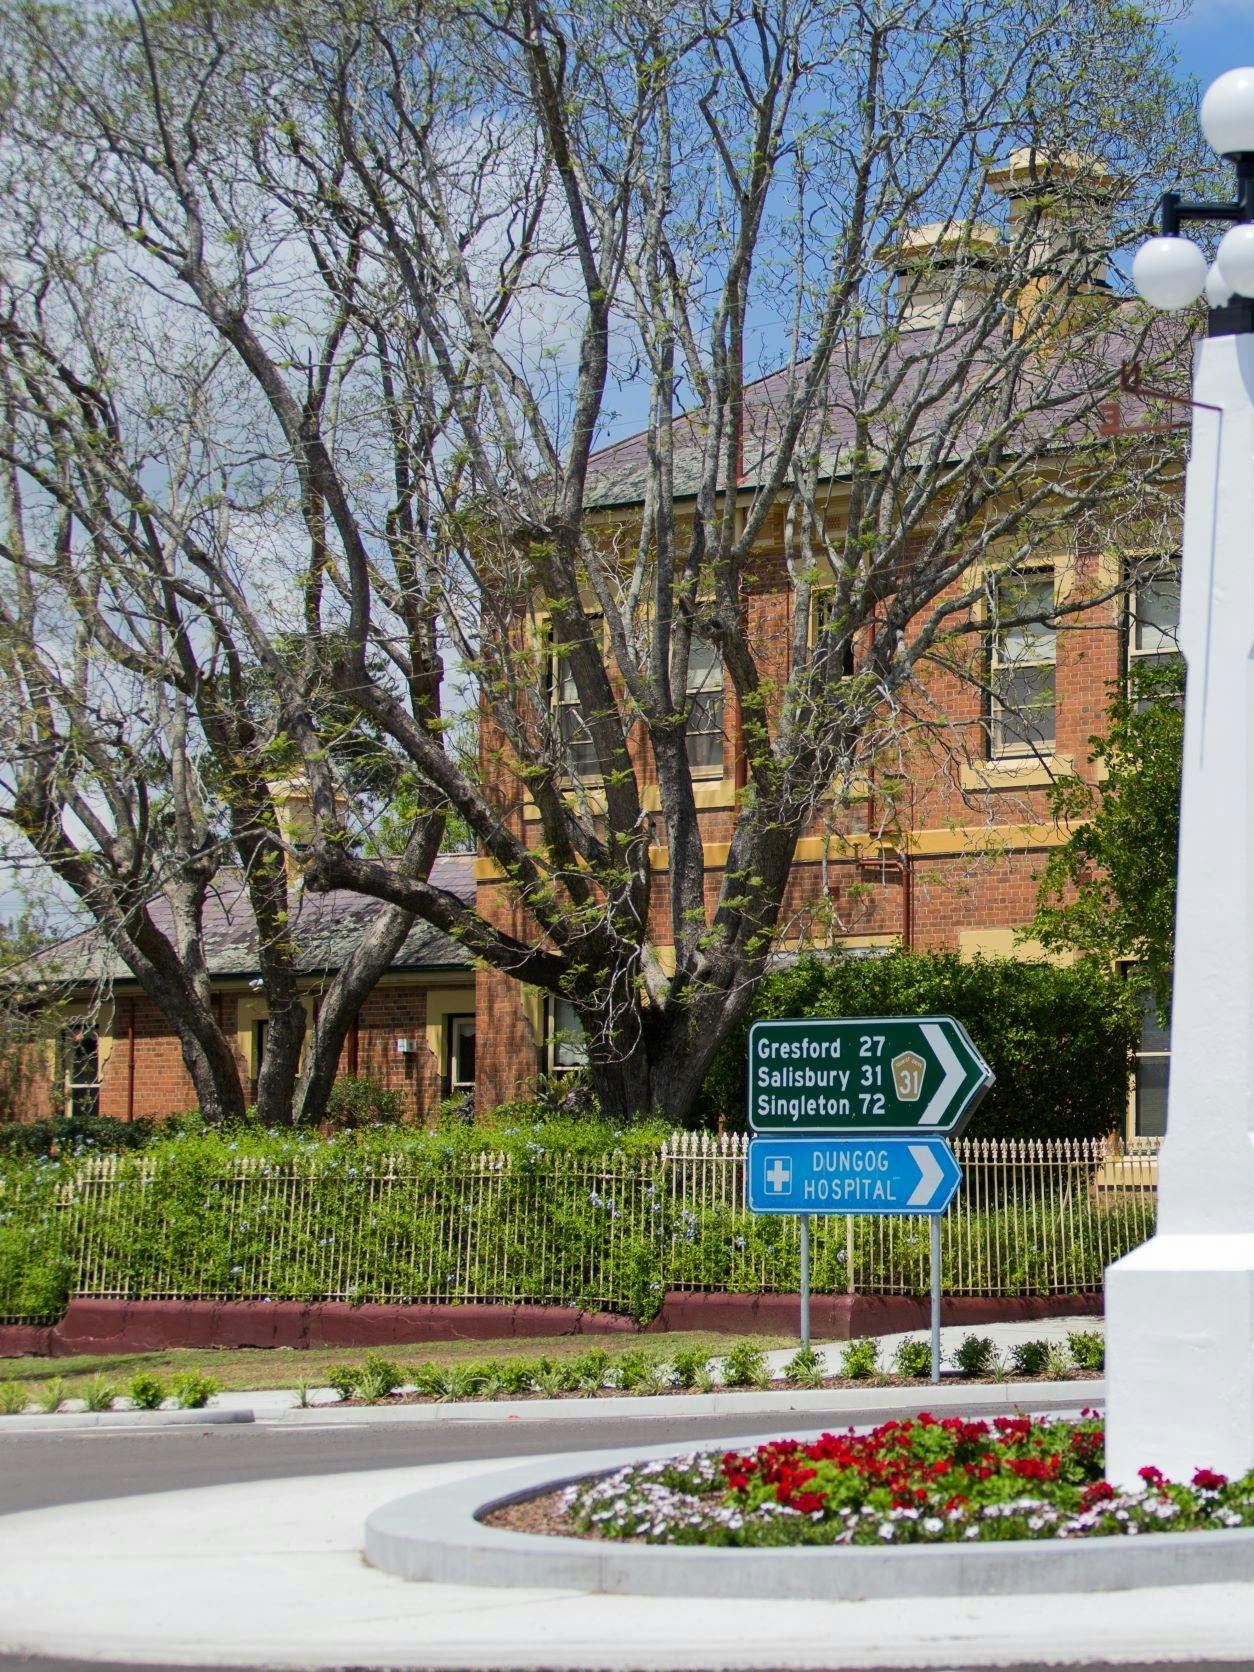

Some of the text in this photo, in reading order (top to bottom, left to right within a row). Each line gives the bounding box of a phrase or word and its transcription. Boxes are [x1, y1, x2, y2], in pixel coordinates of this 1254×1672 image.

[757, 1035, 886, 1059] Gresford 27
[757, 1065, 850, 1092] Salisbury
[860, 1064, 882, 1086] 31
[899, 1070, 918, 1094] 31
[757, 1093, 886, 1122] Singleton 72
[813, 1150, 889, 1171] DUNGOG
[804, 1178, 897, 1200] HOSPITAL
